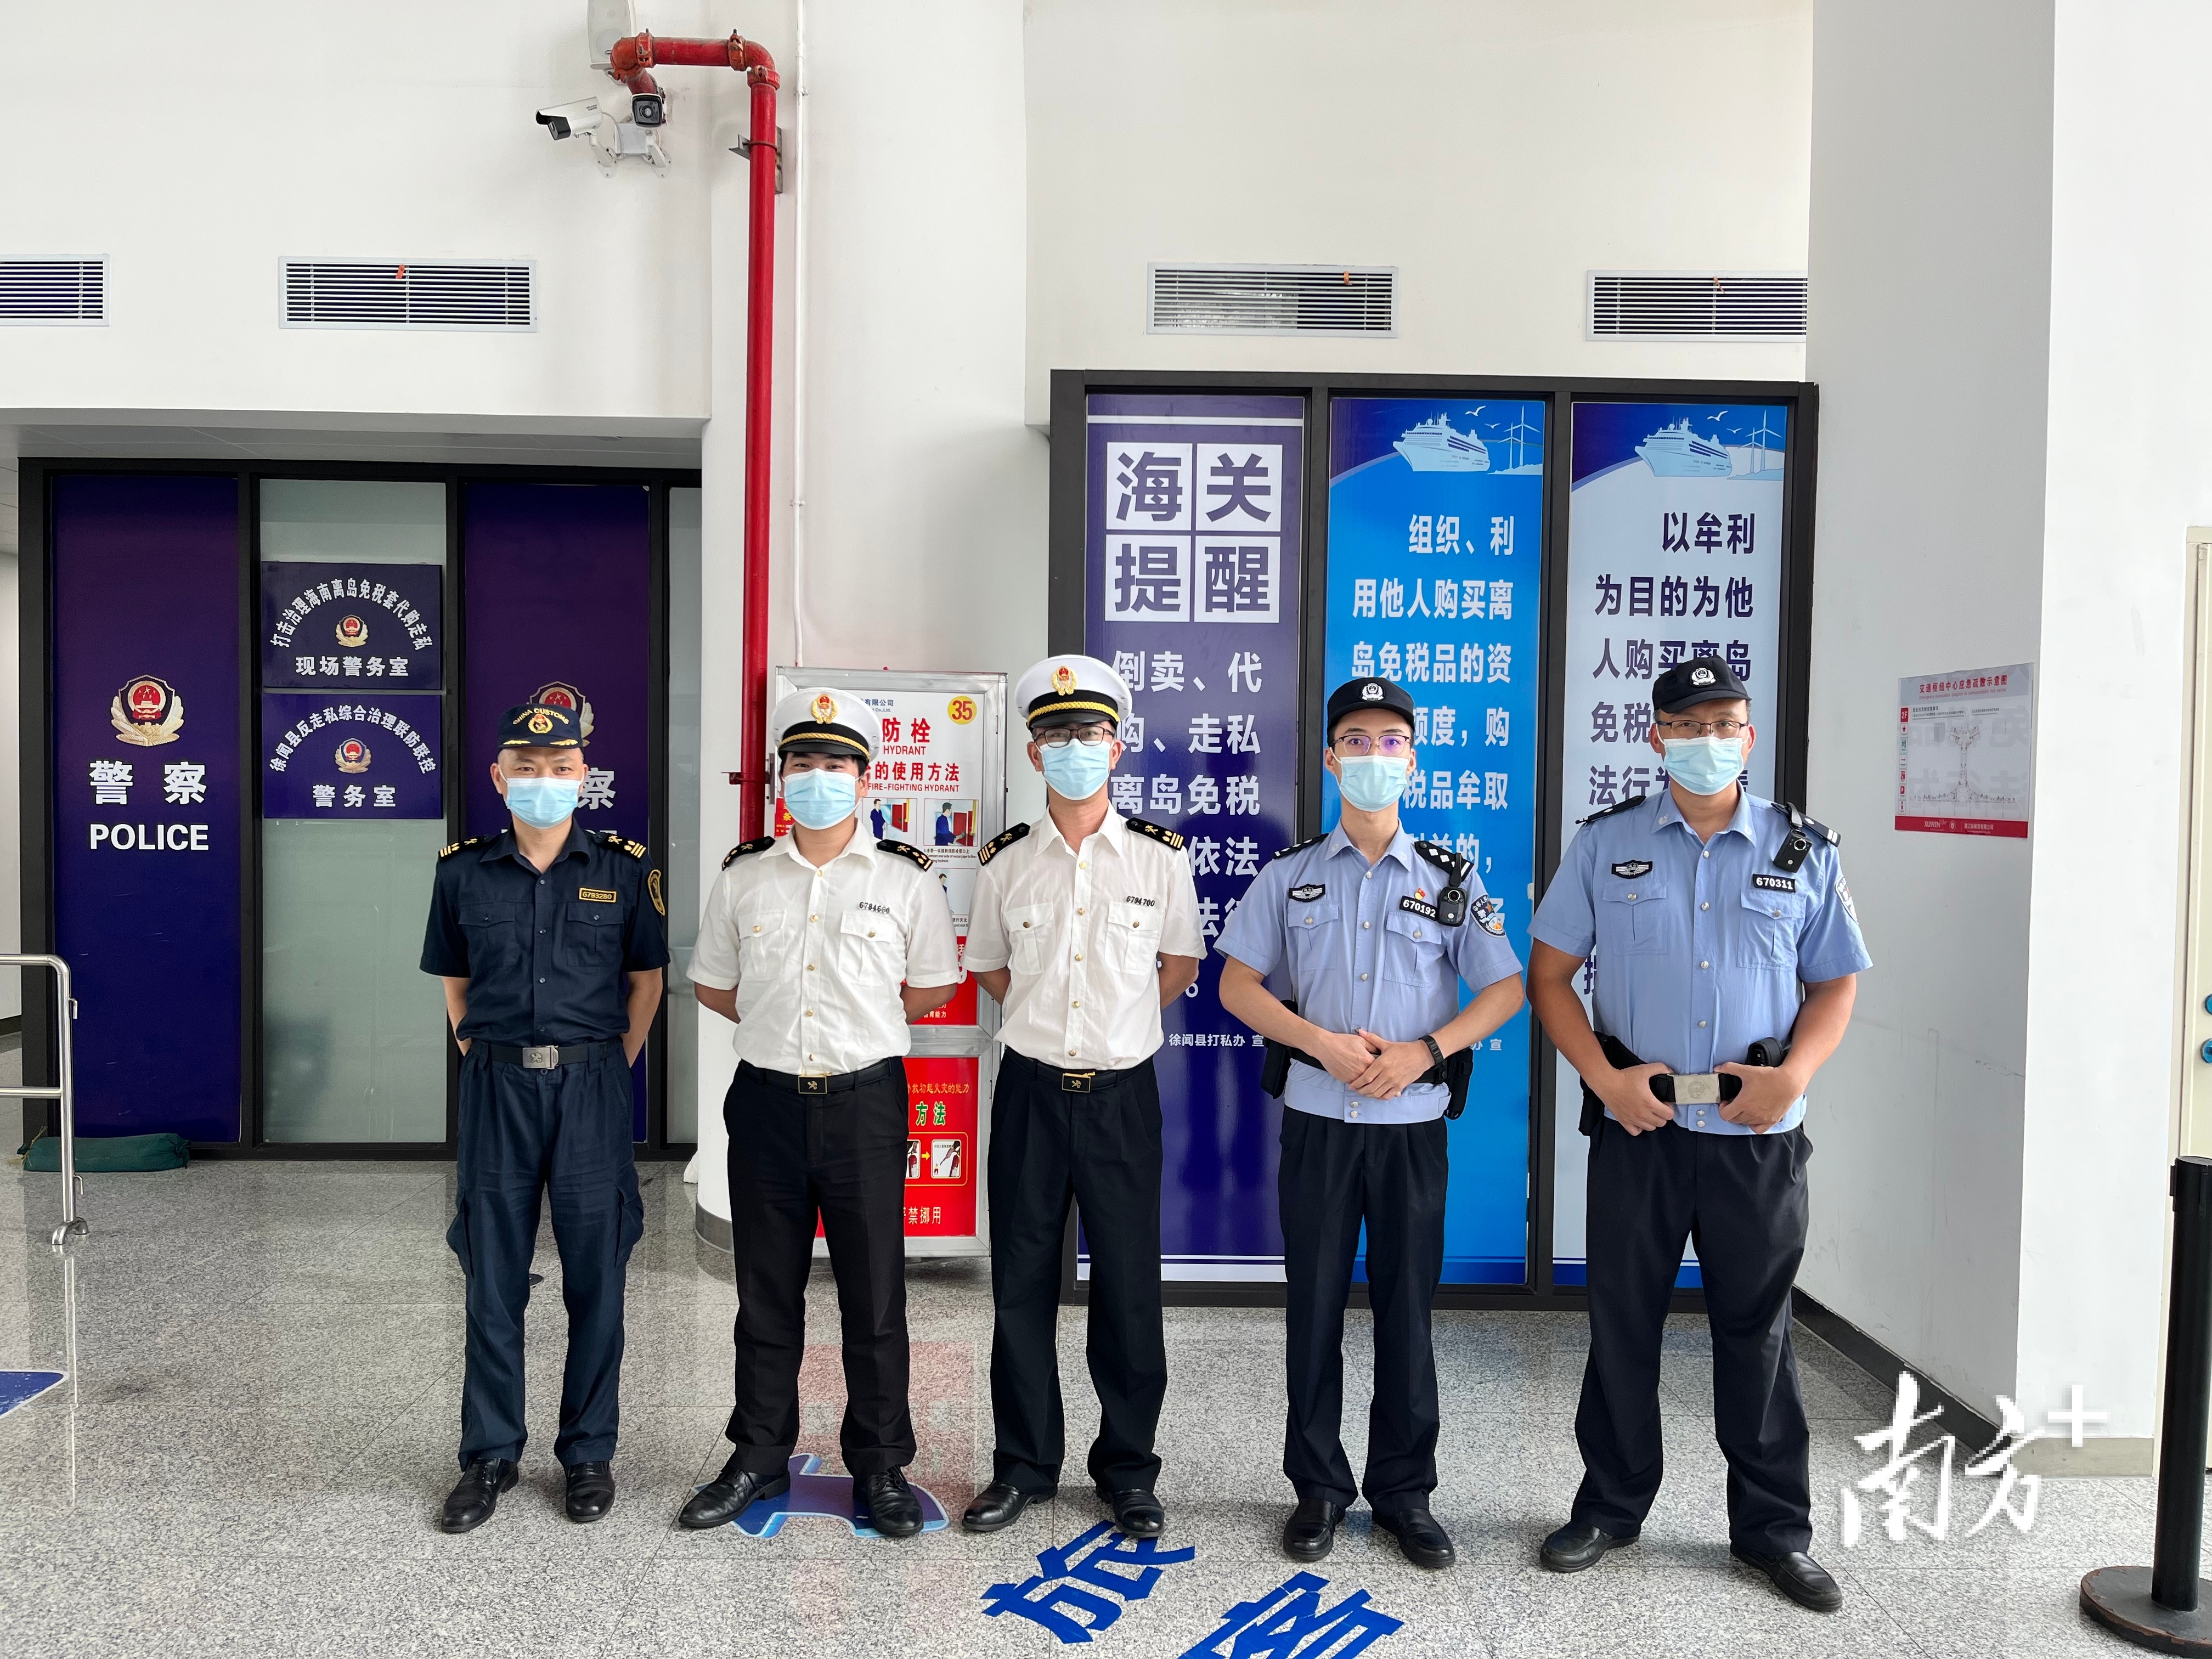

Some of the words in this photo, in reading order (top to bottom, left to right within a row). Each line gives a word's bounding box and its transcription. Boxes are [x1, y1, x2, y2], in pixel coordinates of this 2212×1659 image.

[1116, 451, 1272, 522] 海关
[1408, 514, 1514, 556] 组织、利
[1662, 512, 1755, 555] 以牟利
[1115, 543, 1271, 613] 提醒
[1352, 578, 1514, 620] 用他人购买离
[1594, 574, 1754, 618] 为目的为他
[270, 578, 433, 651] 打击治理海南离岛免税套代购走私
[296, 656, 409, 677] 现场警务室
[1112, 651, 1262, 693] 倒卖、代
[1352, 641, 1511, 684] 岛免税品的资
[1919, 674, 2007, 693] 交通枢纽中心应急疏散示意图
[861, 698, 894, 707] 有限公司
[952, 700, 973, 720] 35
[512, 709, 533, 725] CHINA
[533, 708, 569, 724] CUSTOMS
[1590, 701, 1651, 743] 免税
[269, 704, 436, 774] 徐闻县反走私综合治理联防联控
[883, 745, 926, 755] HYDRANT
[89, 760, 208, 805] 警察
[867, 761, 960, 782] 的使用方法
[313, 785, 396, 808] 警务室
[578, 768, 616, 810] 察
[868, 783, 922, 791] FIRE-FIGHTING
[1111, 774, 1261, 815] 离岛免税
[90, 823, 209, 850] POLICE
[1189, 836, 1260, 877] 依法
[1756, 877, 1793, 890] 670311
[1403, 899, 1436, 918] 670192
[1472, 896, 1489, 912] 中华人民
[1169, 1033, 1245, 1047] 徐闻县打私办
[1252, 1034, 1265, 1047] 宣
[1489, 1038, 1502, 1051] 宣
[915, 1101, 946, 1126] 方法
